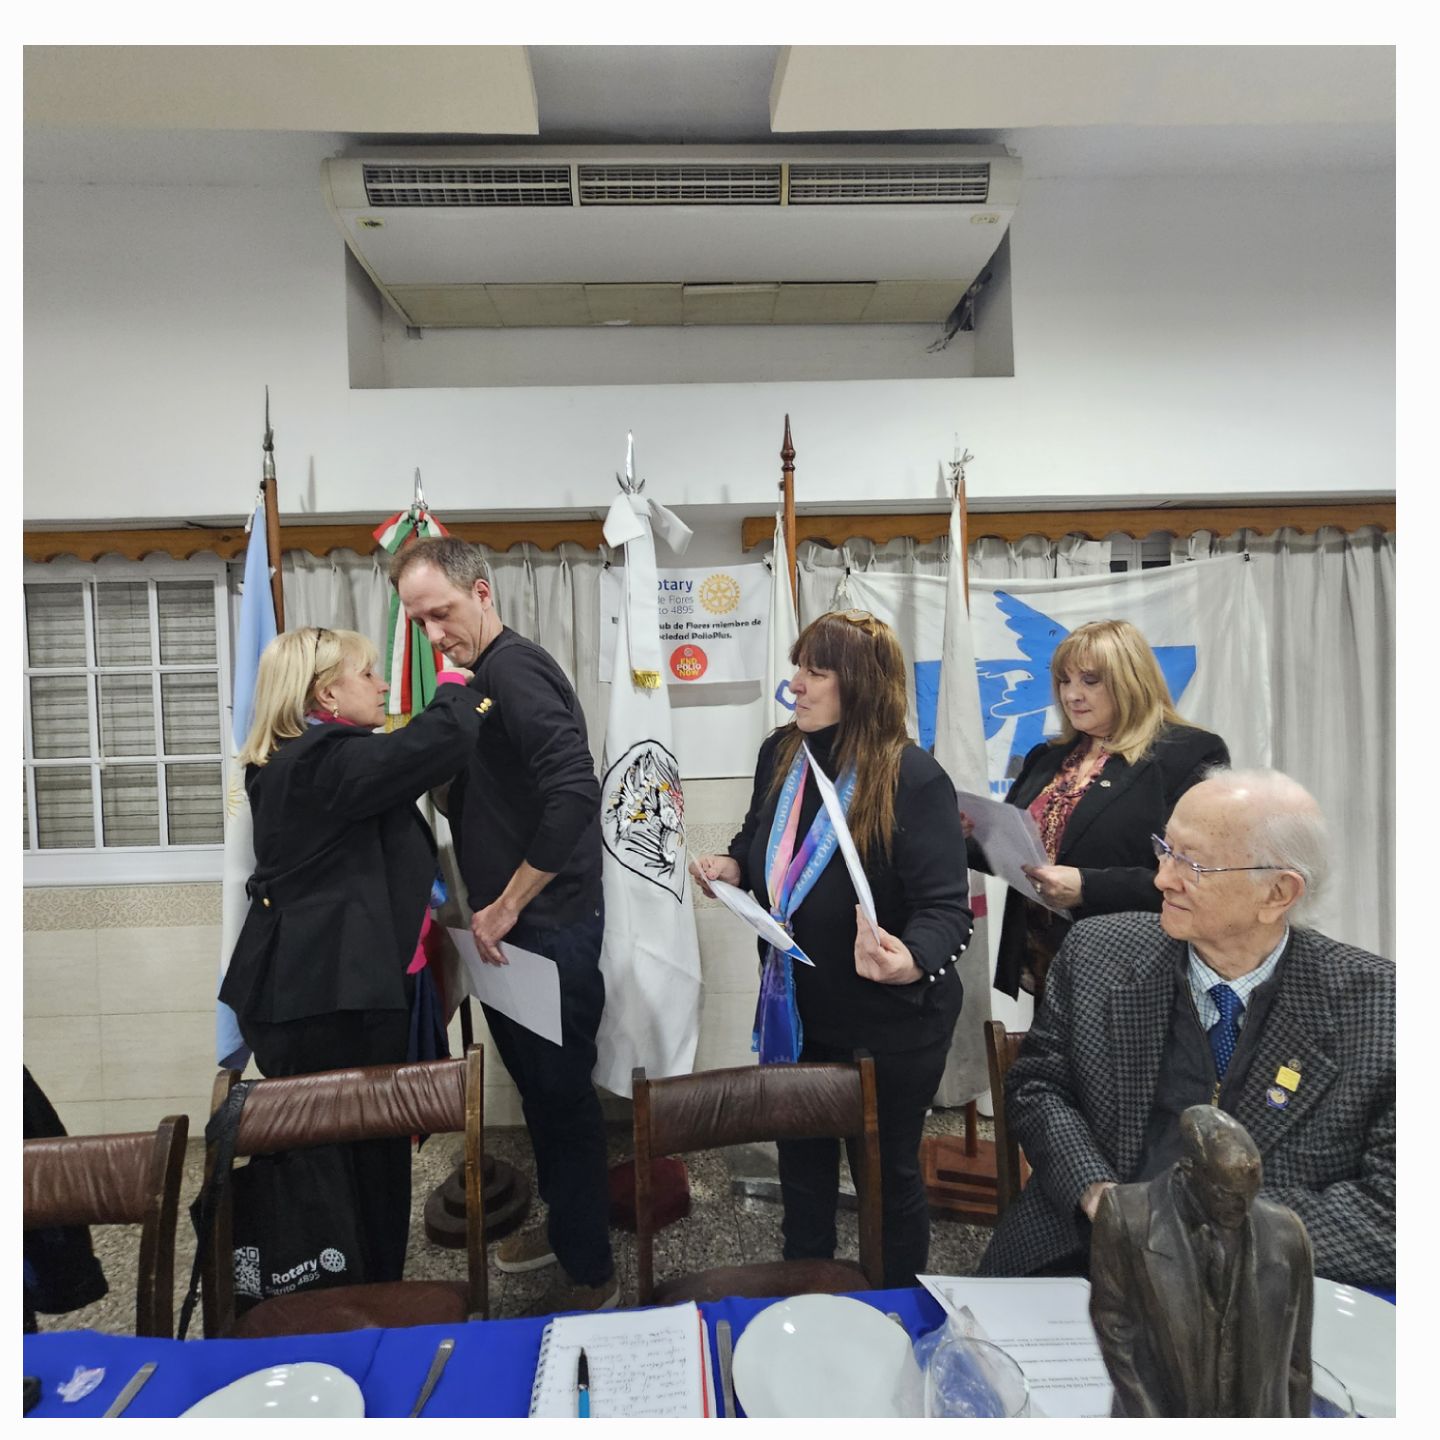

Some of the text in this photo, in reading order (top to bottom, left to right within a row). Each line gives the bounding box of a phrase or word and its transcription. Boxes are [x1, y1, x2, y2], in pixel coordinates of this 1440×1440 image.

[658, 579, 694, 593] tary
[668, 595, 694, 605] Flores
[670, 605, 694, 615] 4895
[659, 621, 672, 631] ub
[673, 621, 684, 631] de
[685, 621, 710, 631] Flores
[751, 618, 762, 627] de
[658, 631, 690, 641] ciedad
[271, 1258, 318, 1285] Rotary
[297, 1271, 321, 1286] 4895
